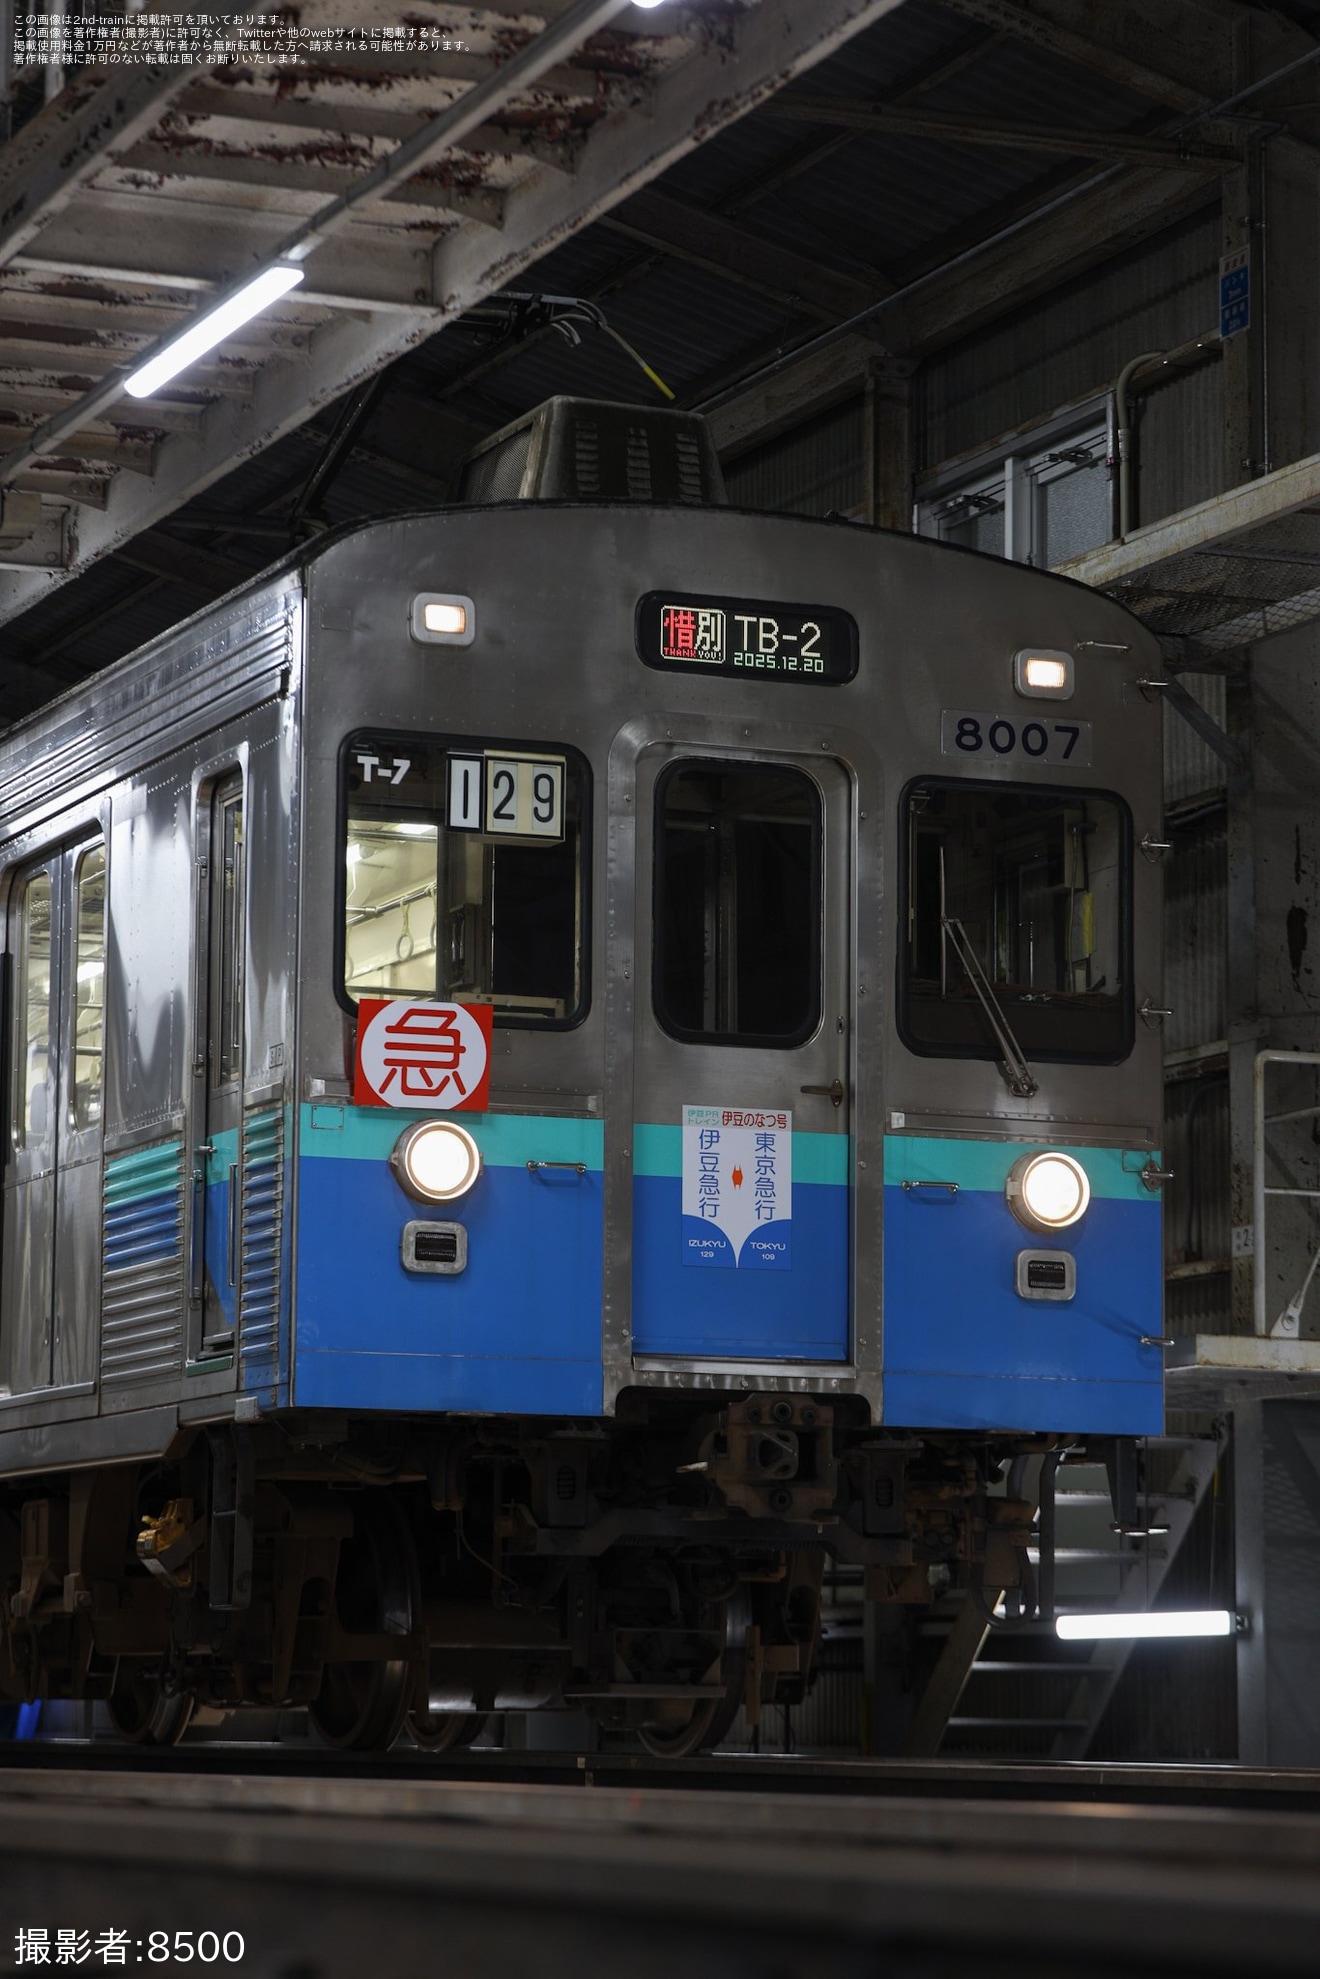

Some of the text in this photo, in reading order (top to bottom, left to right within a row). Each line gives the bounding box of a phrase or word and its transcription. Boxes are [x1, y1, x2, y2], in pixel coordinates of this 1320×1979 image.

[663, 609, 722, 651] 惜別
[734, 615, 821, 658] TB-2
[663, 647, 722, 660] THANK YOU!
[733, 652, 824, 673] 2025.12.20
[955, 717, 1080, 759] 8007
[357, 755, 411, 785] T-7
[378, 1008, 466, 1096] 急
[687, 1109, 719, 1118] 伊豆PR
[722, 1110, 787, 1129] 伊豆のなつ号
[698, 1129, 721, 1218] 伊豆急行
[754, 1132, 776, 1220] 東京急行
[688, 1239, 726, 1248] IZUKYU
[750, 1242, 786, 1251] TOKYU
